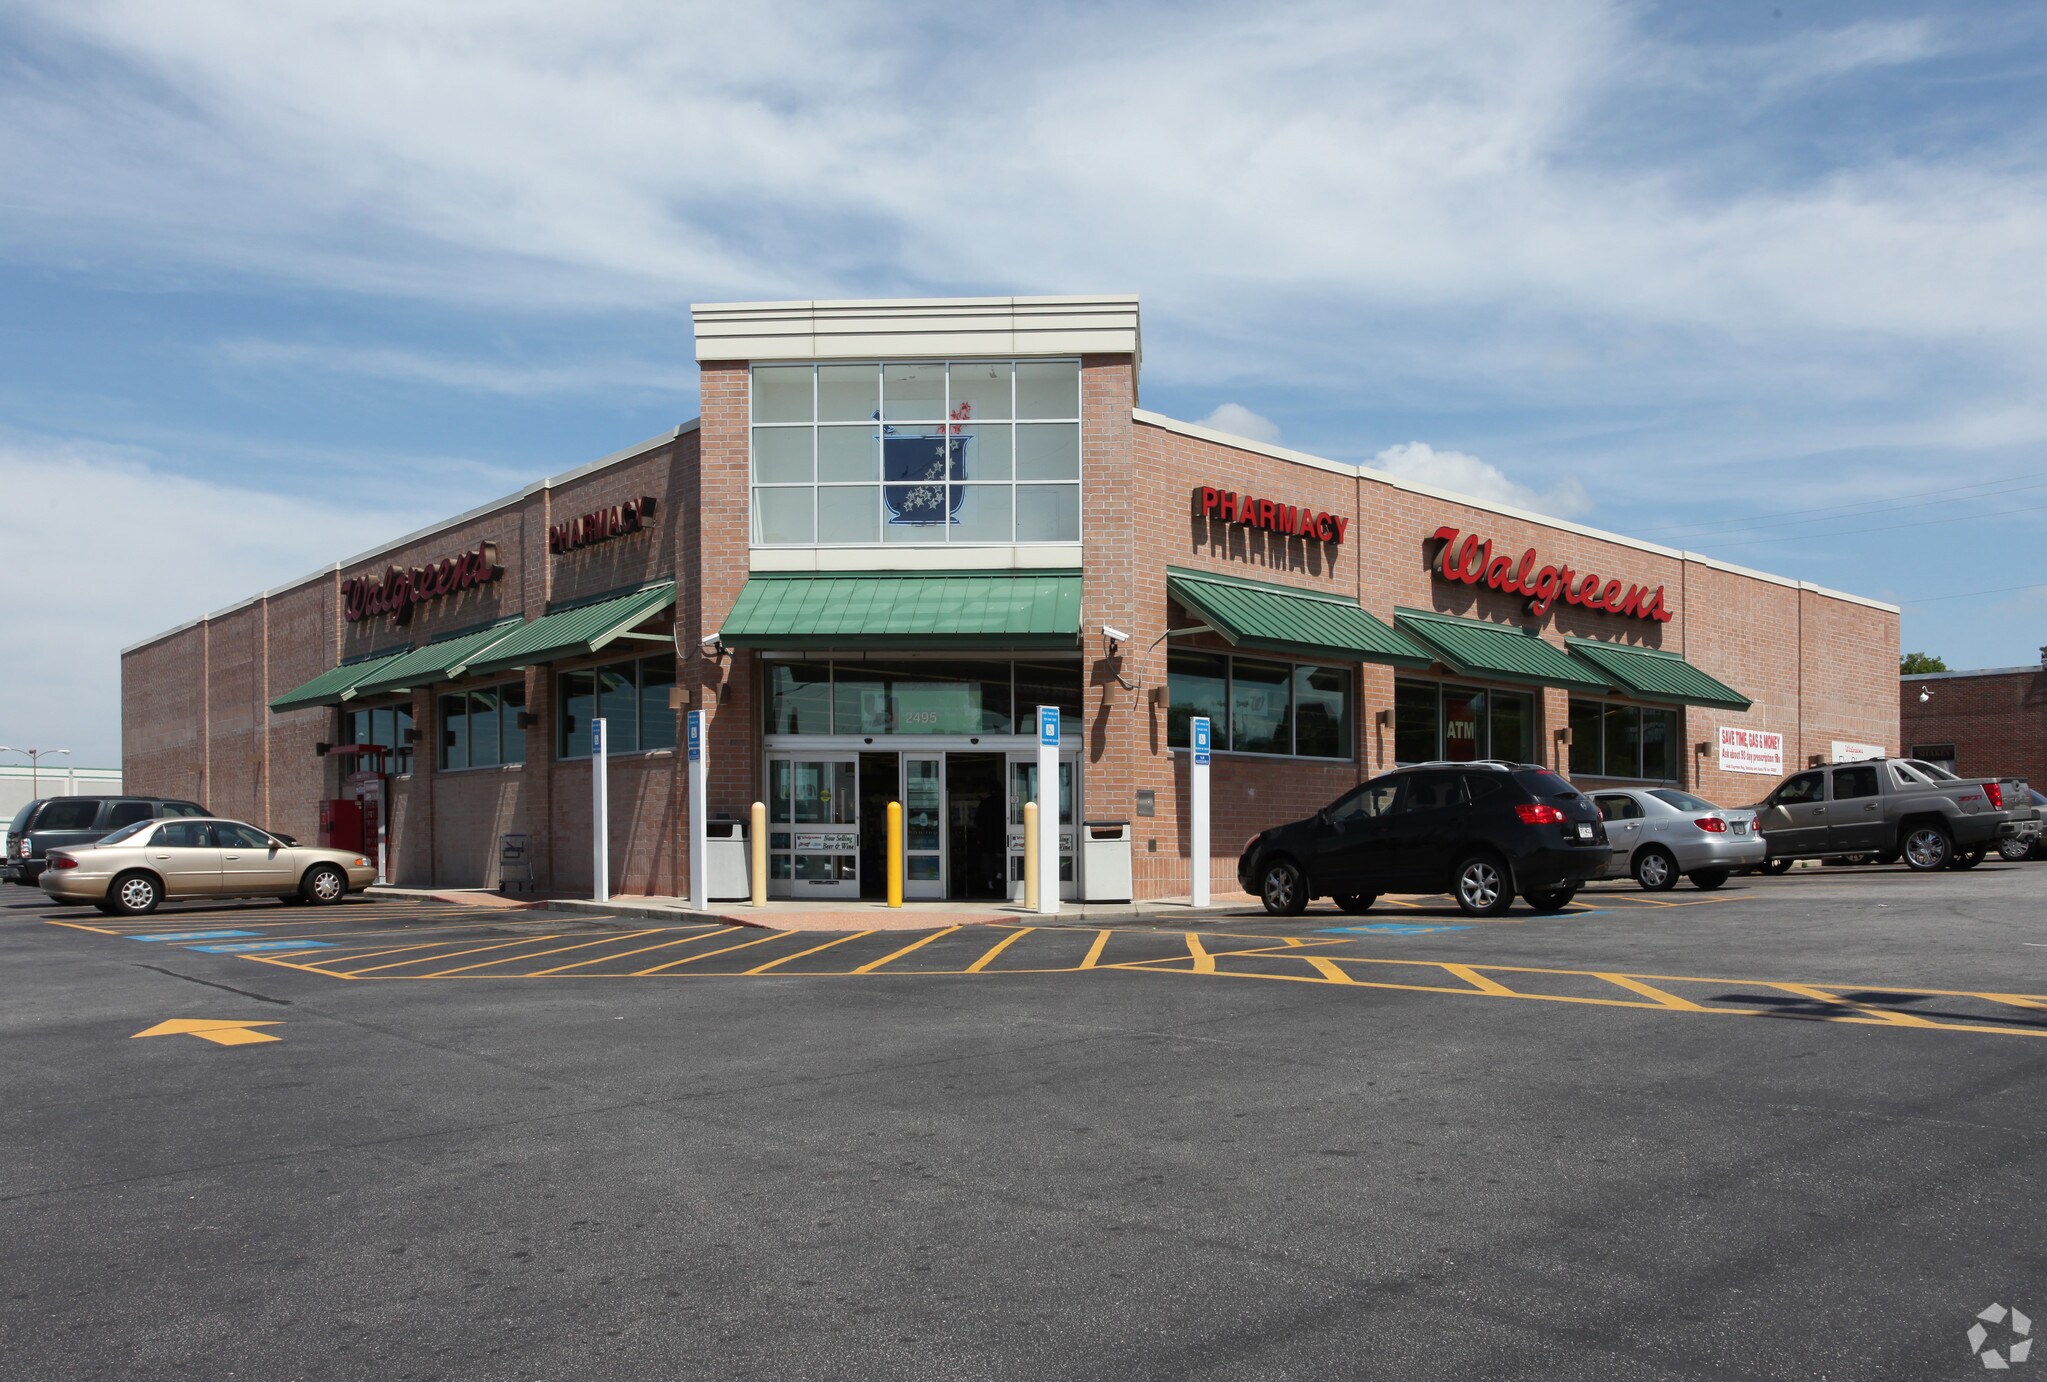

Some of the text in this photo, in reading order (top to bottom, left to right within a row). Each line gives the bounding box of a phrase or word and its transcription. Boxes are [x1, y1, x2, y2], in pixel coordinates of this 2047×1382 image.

[549, 496, 648, 549] PHARMACY
[1202, 486, 1349, 545] PHARMACY
[340, 540, 498, 625] Walgreens
[1434, 526, 1673, 623] Walgreens
[905, 711, 937, 724] 2495
[1447, 720, 1474, 739] ATM
[1722, 729, 1735, 746] SAVE
[1749, 733, 1759, 748] GAS
[1759, 734, 1763, 749] &
[1764, 735, 1780, 751] MONEY
[1730, 749, 1740, 760] about
[836, 834, 853, 843] Selling
